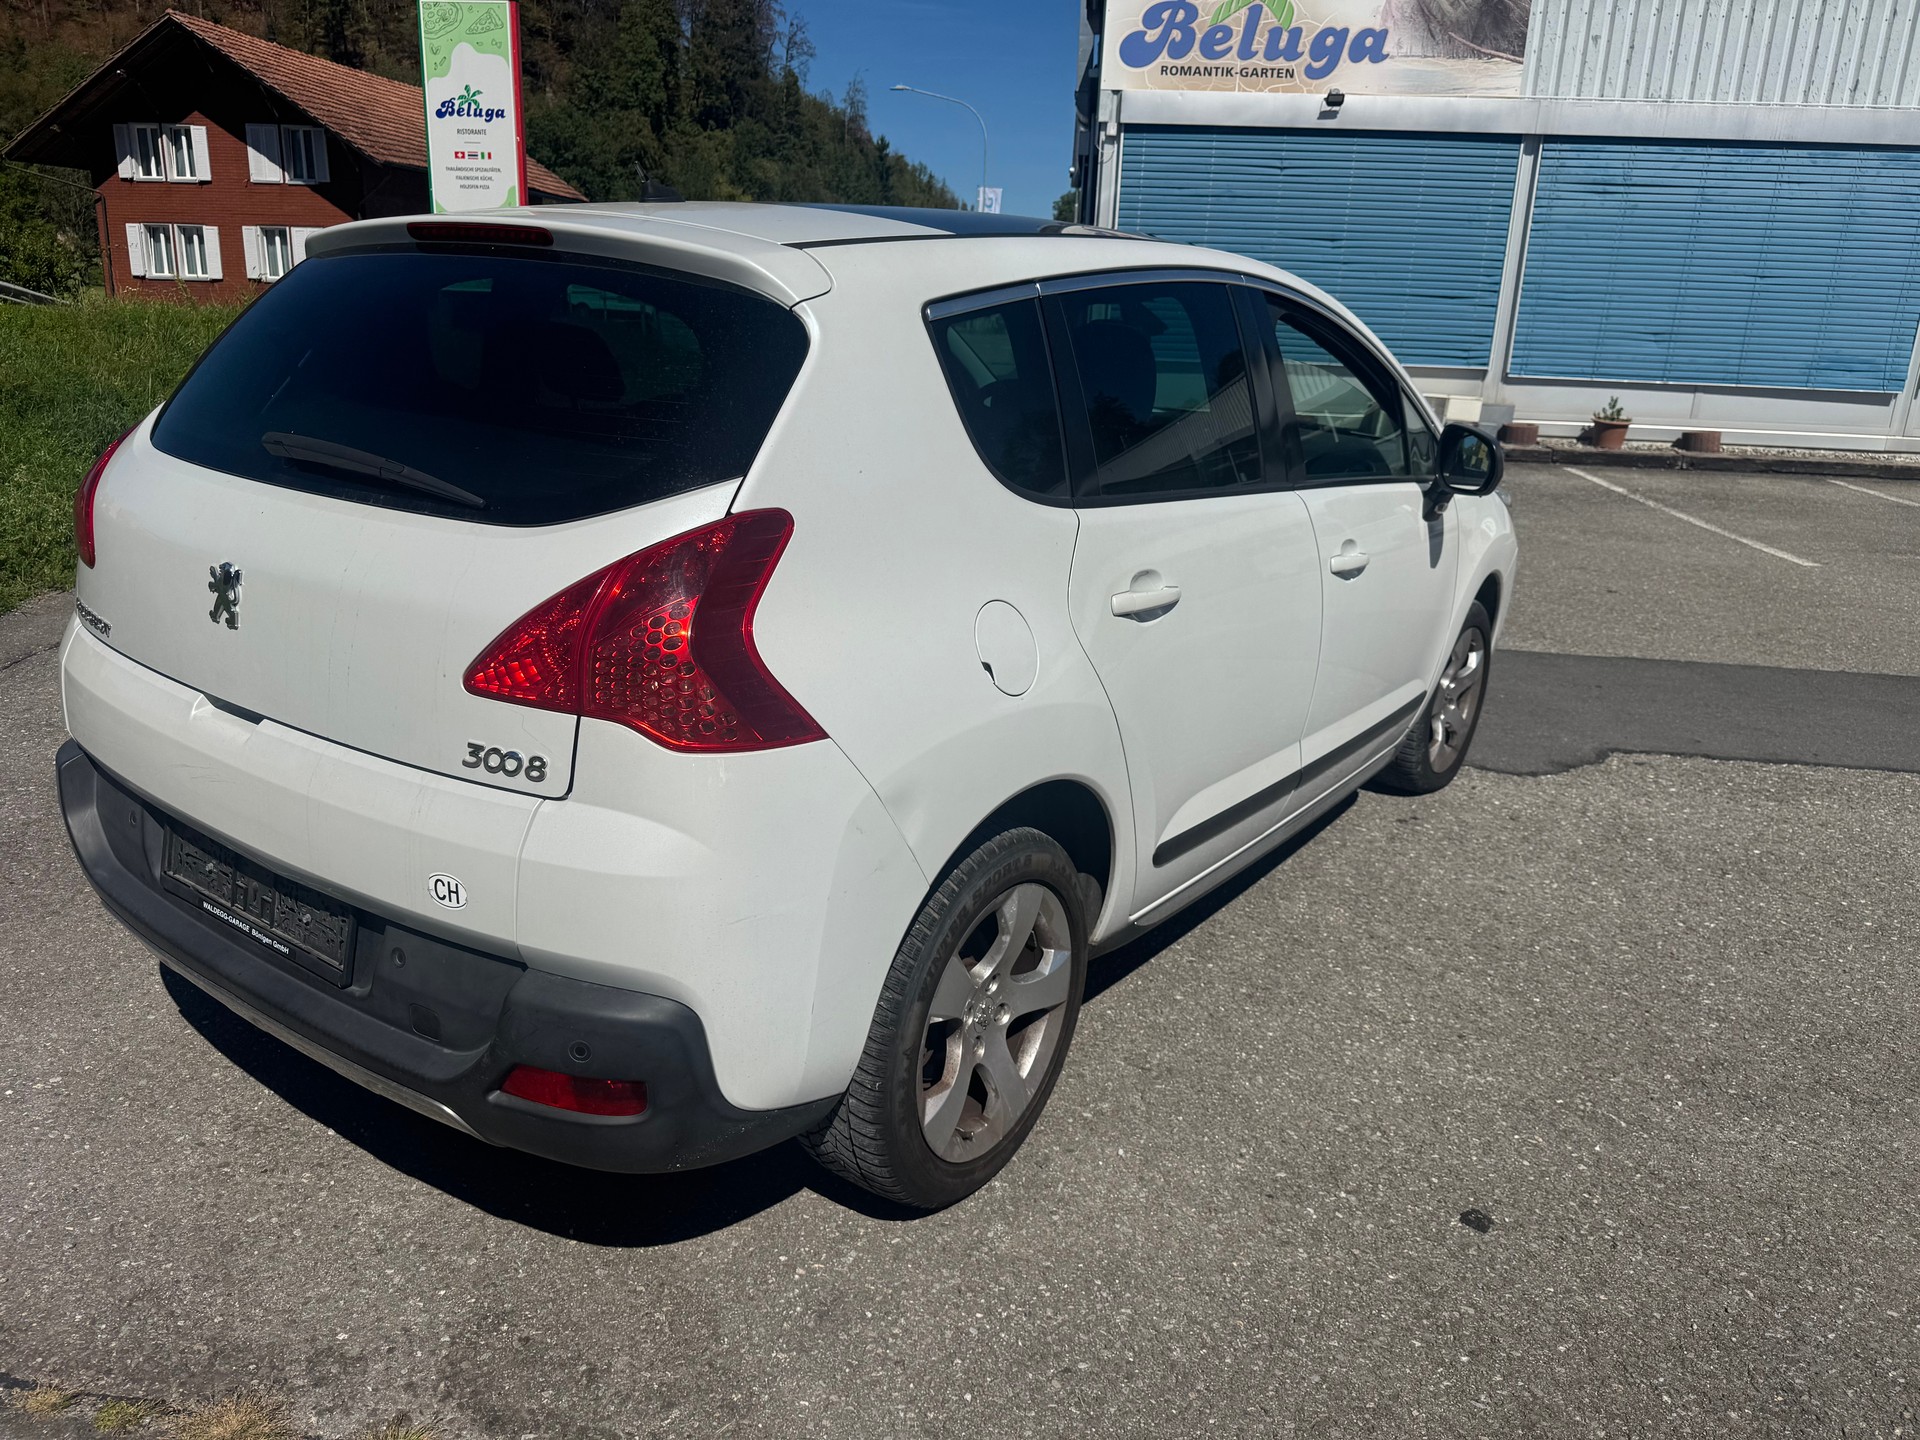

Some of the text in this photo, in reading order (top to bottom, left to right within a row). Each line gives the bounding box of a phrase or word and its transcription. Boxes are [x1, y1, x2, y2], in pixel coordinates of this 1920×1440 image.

[1119, 0, 1390, 80] Beluga
[1160, 64, 1295, 79] ROMANTIK-GARTEN
[436, 97, 506, 123] Beluga
[456, 128, 487, 136] RISTORANTE
[461, 739, 549, 783] 3008
[434, 877, 460, 905] CH
[972, 857, 1022, 905] SPORT
[202, 900, 290, 955] WALDEGG-GARAGE Bönigen GmbH
